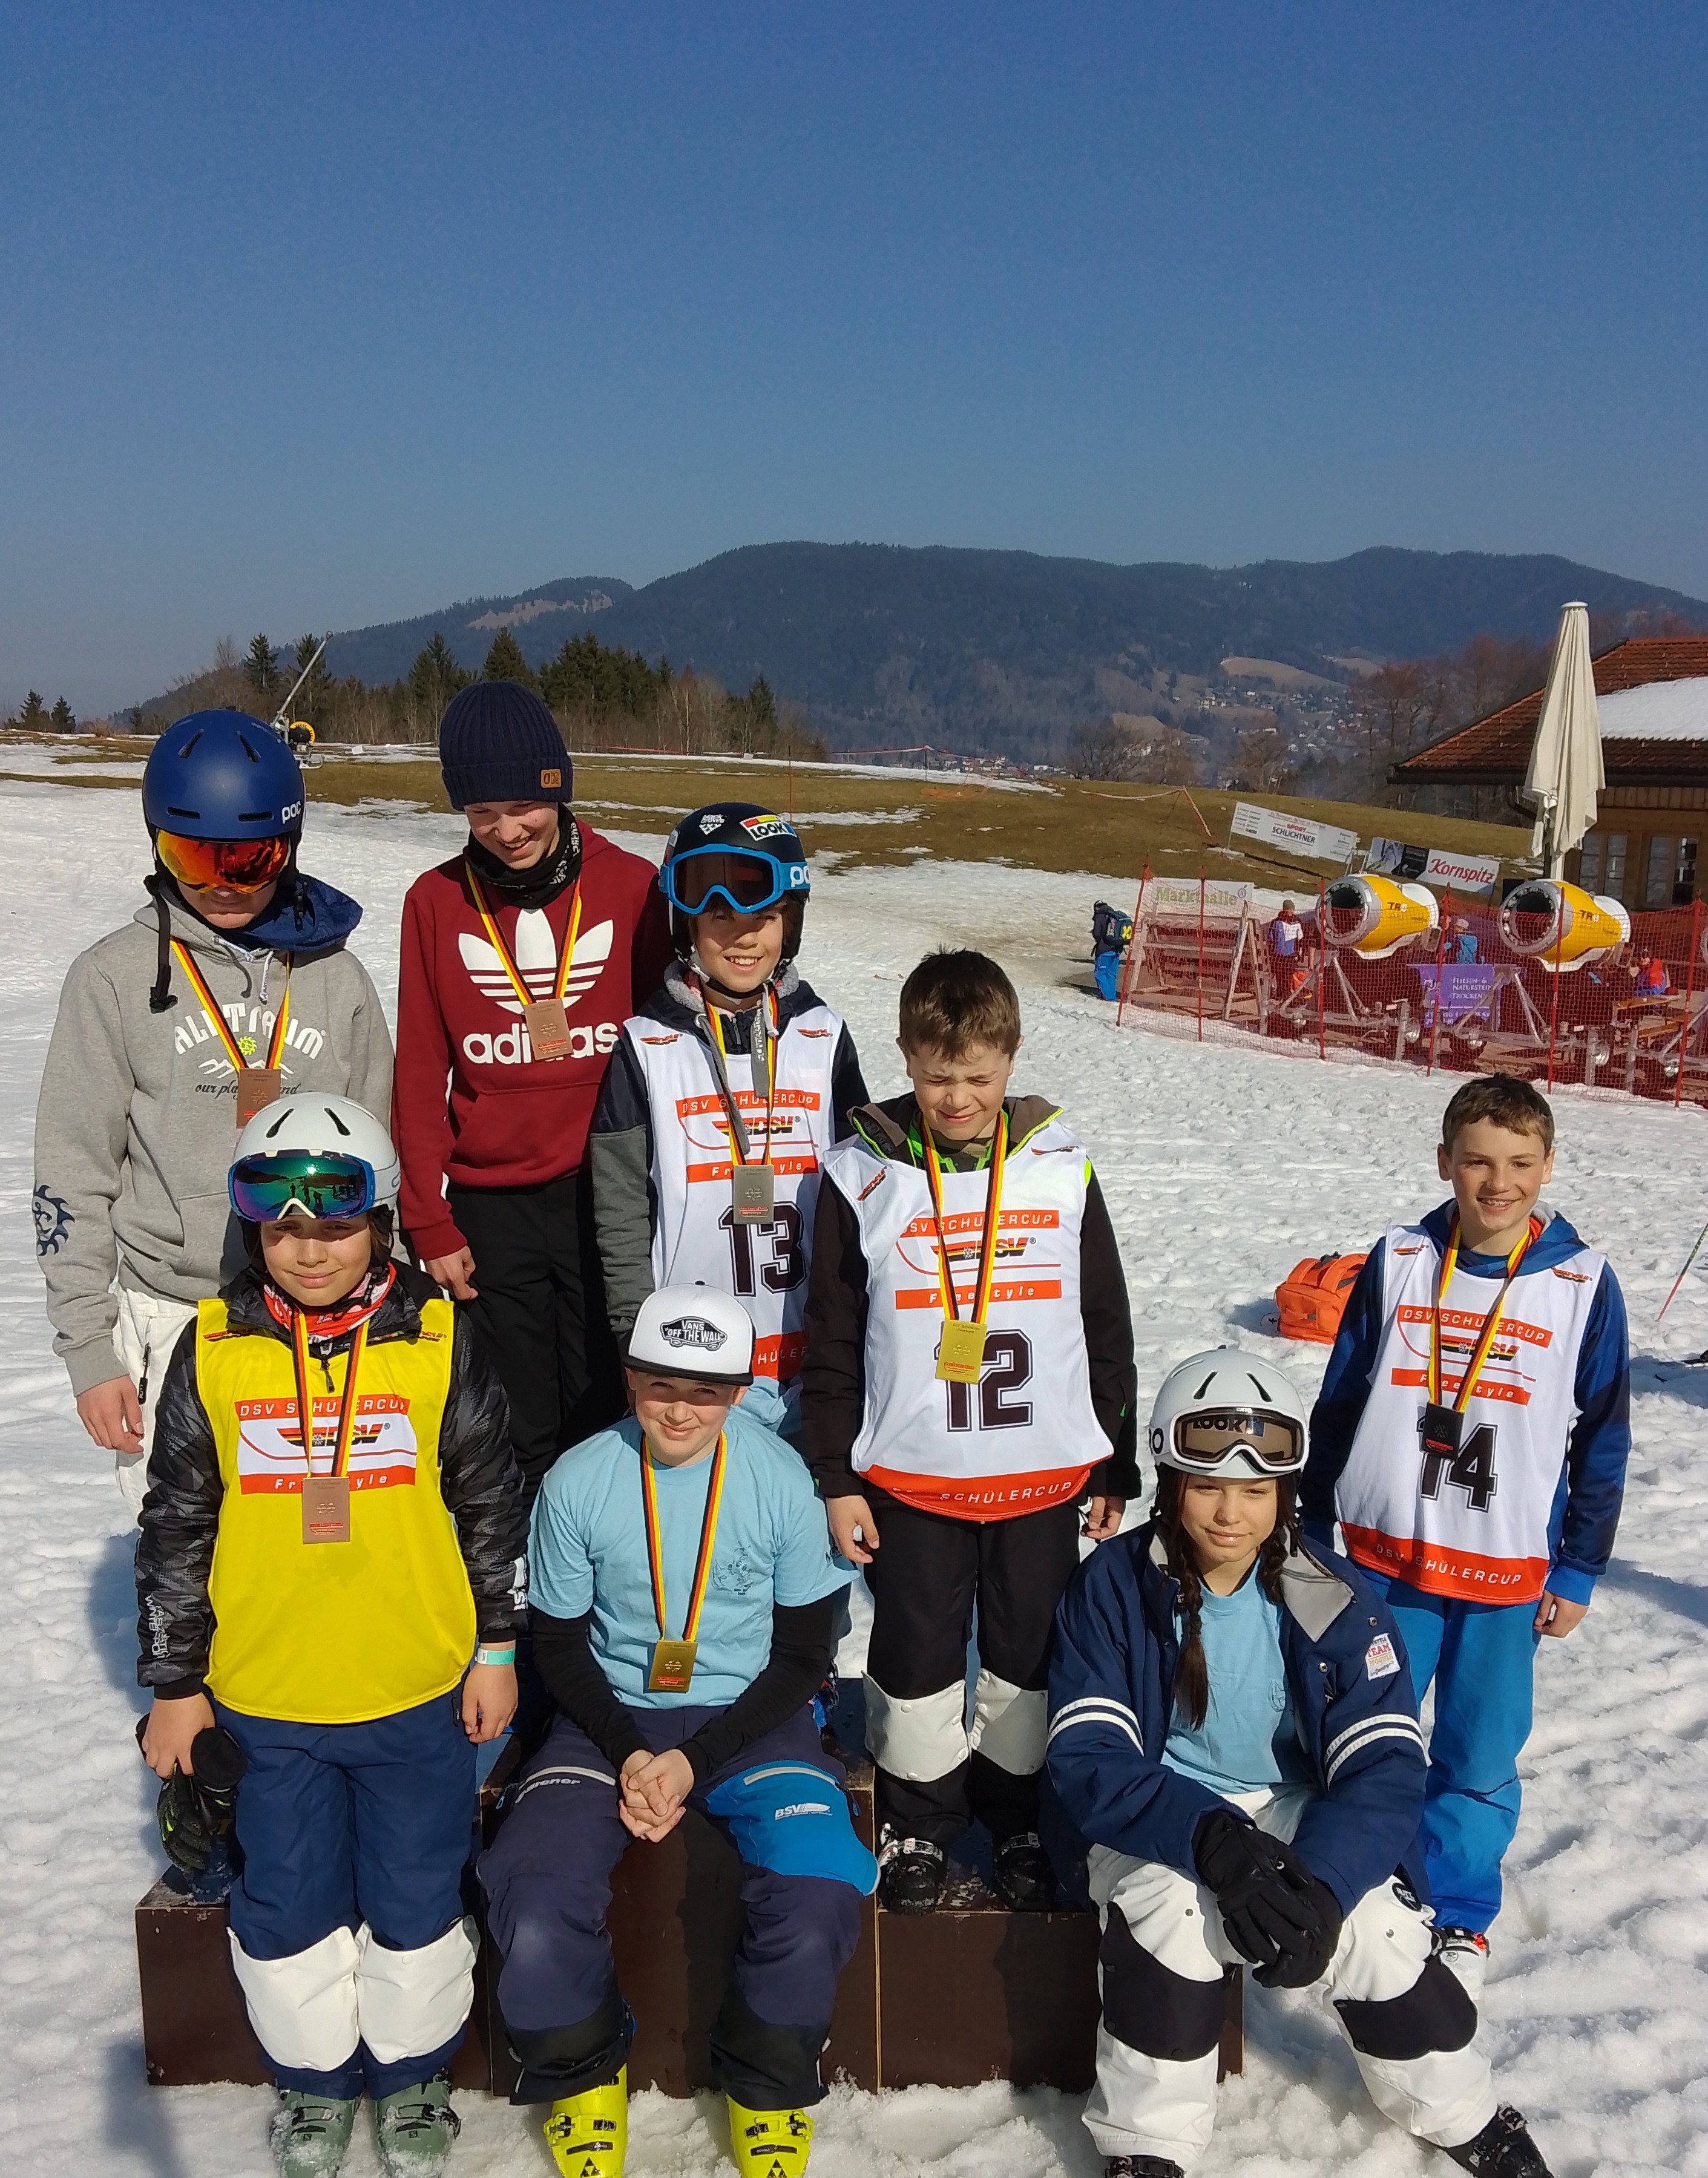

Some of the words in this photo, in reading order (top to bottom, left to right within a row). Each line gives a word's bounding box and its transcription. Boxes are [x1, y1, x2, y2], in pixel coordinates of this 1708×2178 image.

[750, 822, 787, 839] LOOK
[1272, 827, 1316, 844] SCHLICHTNER
[1286, 824, 1307, 833] SPORT
[1428, 858, 1494, 884] Kornspitz
[463, 1023, 619, 1064] adias
[195, 1083, 217, 1094] our
[682, 1099, 709, 1114] DSV
[711, 1161, 802, 1176] Fryle
[940, 1213, 1053, 1232] SCHÜERCUP
[718, 1201, 807, 1297] 13
[929, 1286, 1034, 1304] Feetyle
[682, 1320, 705, 1330] VANS
[1441, 1311, 1546, 1342] SCHÜERCUP
[682, 1330, 700, 1342] THE
[933, 1329, 1033, 1432] 12
[1419, 1374, 1514, 1398] Feetyle
[241, 1403, 275, 1416] DSV
[1192, 1419, 1247, 1434] LOOK
[1416, 1415, 1499, 1514] 14
[274, 1473, 387, 1490] Fryle
[939, 1481, 1072, 1504] SCHÜLERCUP
[1376, 1544, 1404, 1561] DSV
[1368, 1642, 1391, 1658] TEAM
[775, 1804, 800, 1819] BSV
